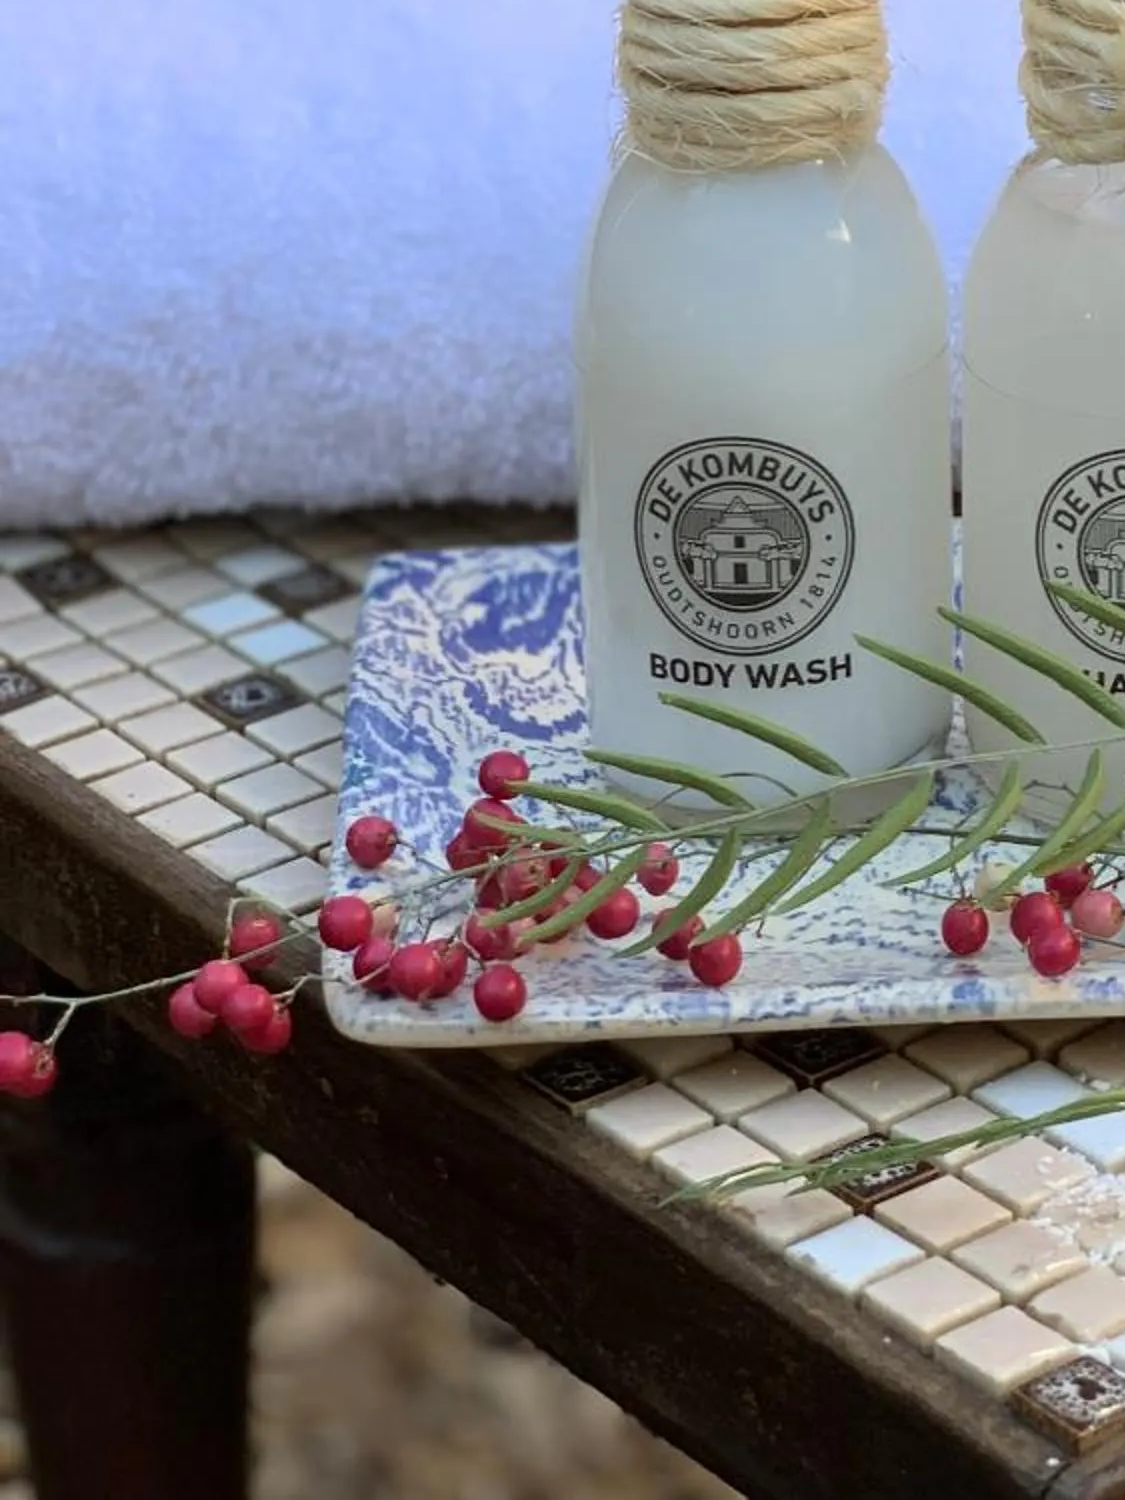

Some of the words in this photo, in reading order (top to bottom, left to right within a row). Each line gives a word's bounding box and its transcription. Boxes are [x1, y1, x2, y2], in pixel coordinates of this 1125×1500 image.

[649, 477, 683, 524] DE
[677, 451, 835, 524] KOMBUYS
[1053, 488, 1091, 534] DE
[652, 555, 796, 640] OUDTSHOORN
[800, 556, 837, 609] 1814
[650, 652, 736, 689] BODY
[745, 652, 852, 689] WASH
